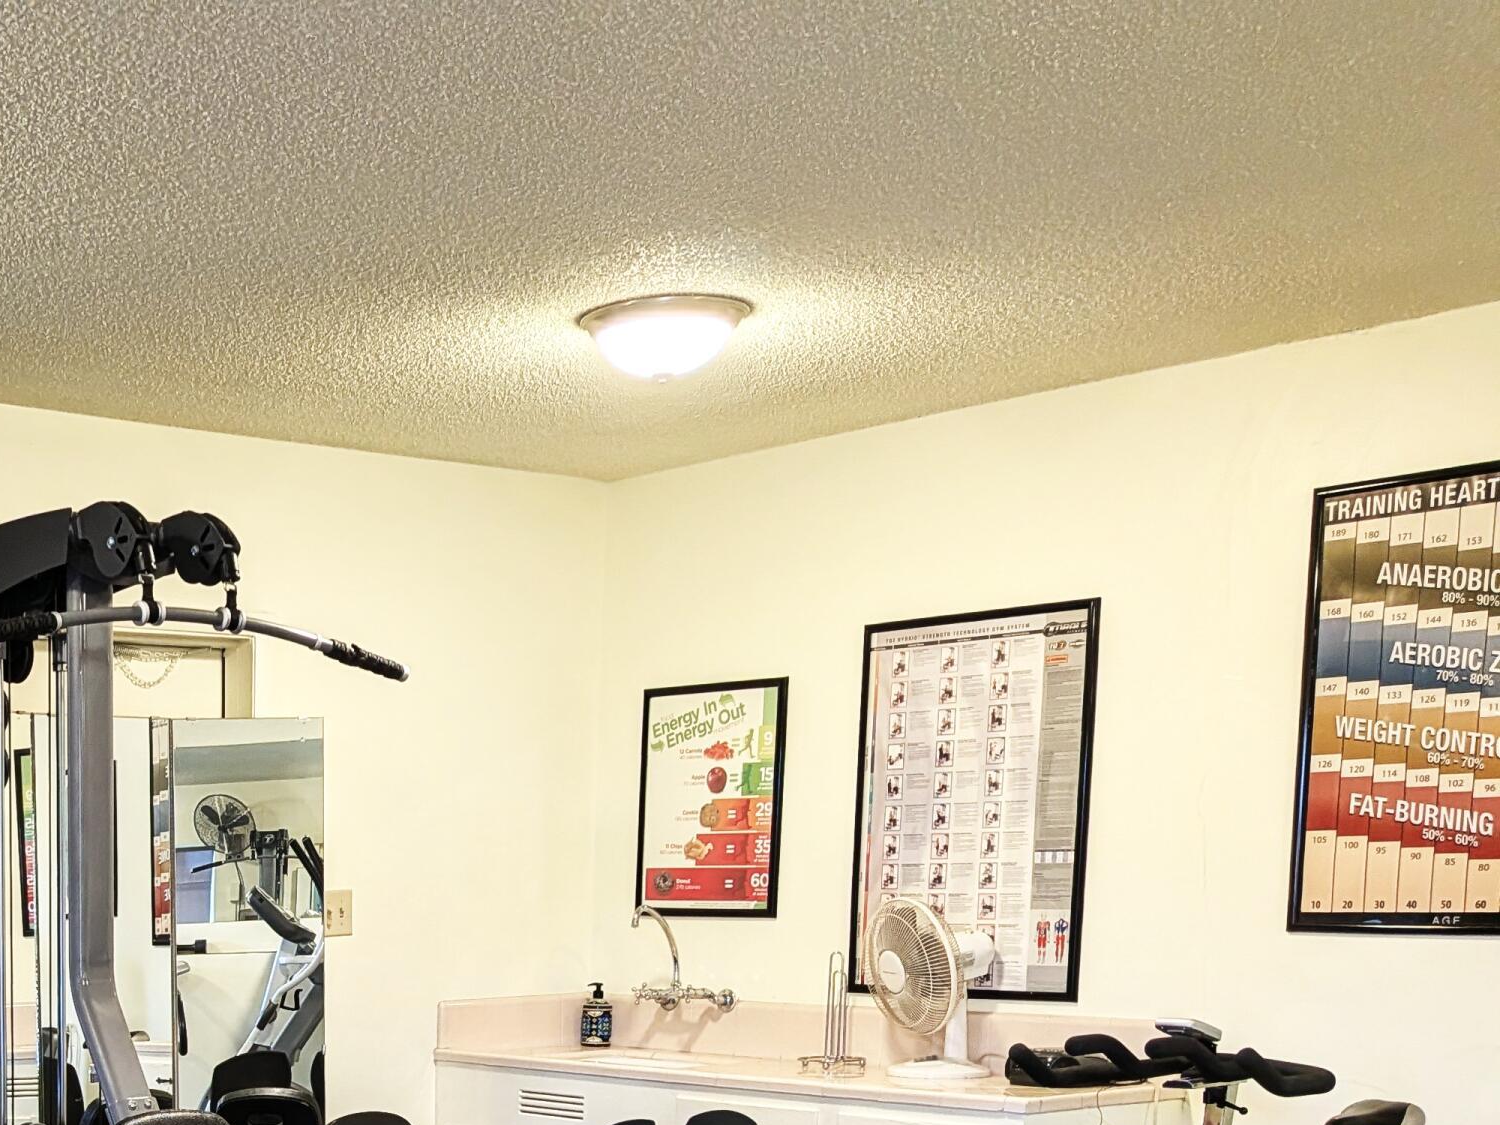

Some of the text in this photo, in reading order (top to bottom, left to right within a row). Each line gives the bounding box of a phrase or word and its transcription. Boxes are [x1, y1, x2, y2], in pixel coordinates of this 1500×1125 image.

[1326, 477, 1500, 522] TRAINING HEART
[1331, 529, 1347, 537] 189
[1364, 530, 1379, 539] 180
[1398, 532, 1412, 541] 171
[1431, 534, 1448, 543] 162
[1466, 536, 1482, 545] 153
[1442, 592, 1465, 604] 80%
[1476, 595, 1500, 607] 90%
[1327, 607, 1341, 616] 168
[1359, 610, 1374, 618] 160
[1391, 613, 1407, 621] 152
[1426, 615, 1442, 624] 144
[1460, 619, 1477, 627] 136
[1388, 641, 1483, 671] AEROBIC
[1436, 669, 1459, 682] 70%
[1470, 673, 1494, 686] 80%
[1322, 684, 1337, 692] 147
[1354, 687, 1370, 695] 140
[1387, 691, 1402, 699] 133
[1420, 694, 1436, 703] 126
[1454, 699, 1470, 707] 119
[652, 708, 700, 738] Energy
[703, 701, 717, 716] In
[666, 702, 747, 748] Energy Out
[1335, 715, 1416, 747] WEIGHT
[764, 731, 773, 746] 9
[1318, 760, 1332, 768] 126
[1427, 752, 1450, 766] 60%
[1461, 756, 1485, 770] 70%
[1349, 765, 1364, 773] 120
[760, 767, 773, 782] 15
[1415, 774, 1430, 783] 108
[1448, 779, 1464, 787] 102
[1484, 784, 1496, 792] 96
[755, 802, 771, 817] 29
[1349, 793, 1494, 836] FAT-BURNING
[1313, 836, 1327, 844] 105
[1422, 829, 1445, 841] 50%
[1455, 833, 1478, 847] 60%
[755, 840, 770, 854] 35
[1344, 841, 1358, 849] 100
[1376, 846, 1386, 854] 95
[1410, 852, 1421, 860] 90
[1478, 863, 1489, 871] 80
[751, 873, 768, 887] 60
[1311, 900, 1321, 909] 10
[1342, 900, 1353, 909] 20
[1374, 900, 1385, 909] 30
[1406, 900, 1417, 909] 40
[1441, 900, 1452, 908] 50
[1475, 900, 1486, 908] 60
